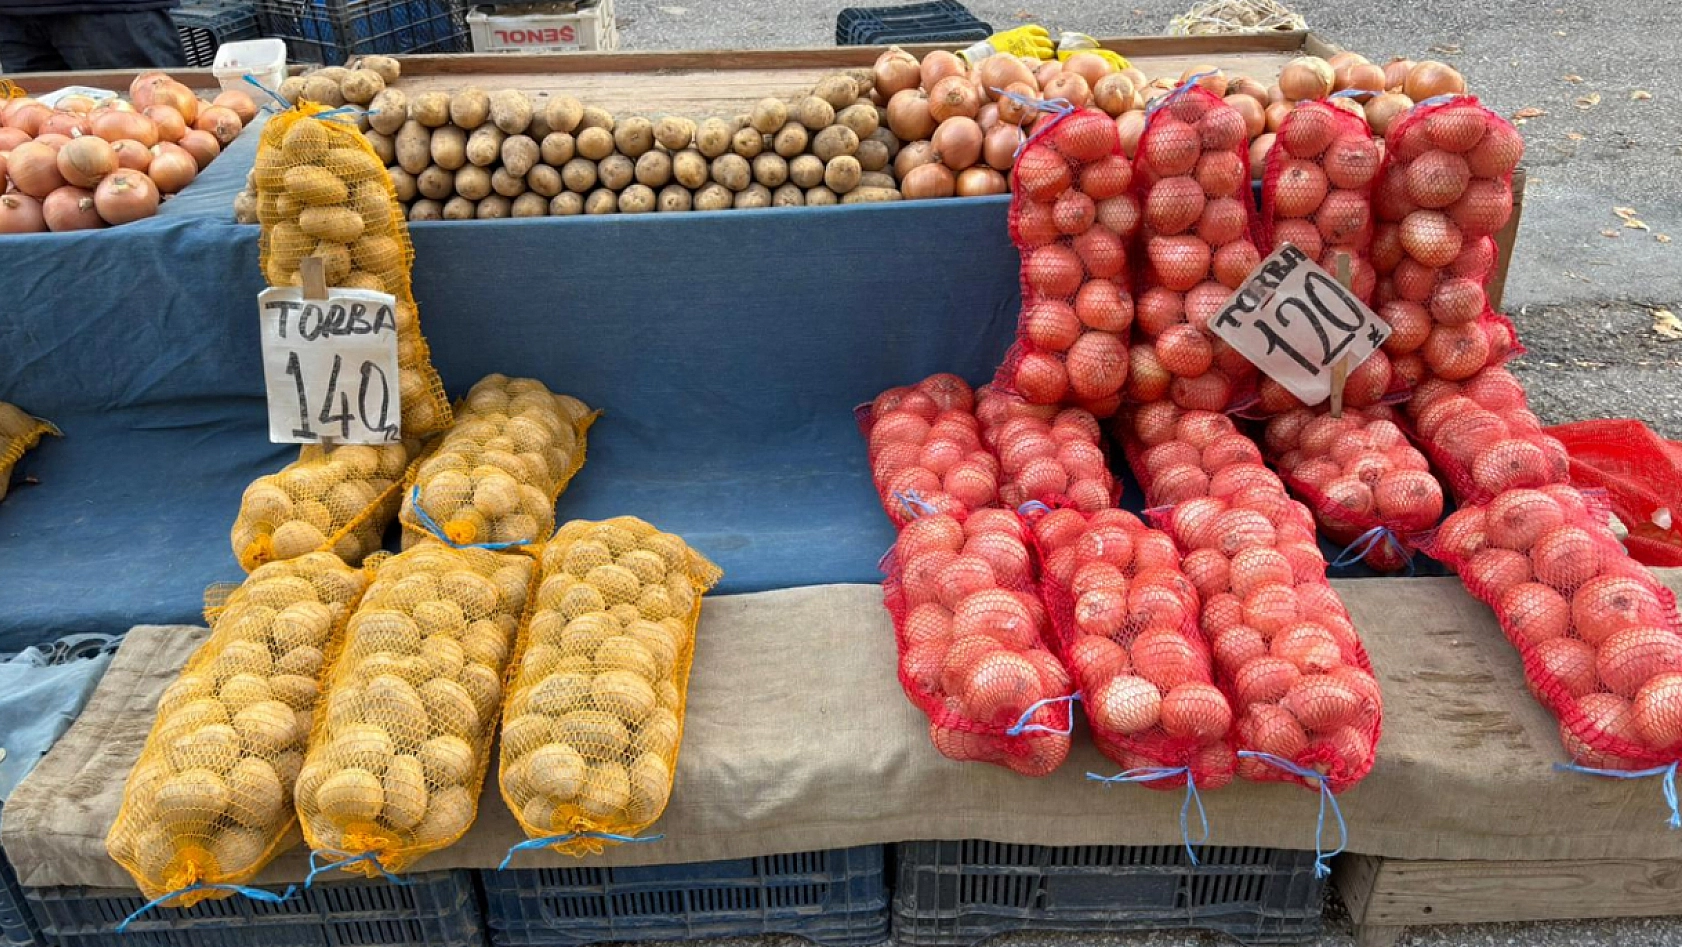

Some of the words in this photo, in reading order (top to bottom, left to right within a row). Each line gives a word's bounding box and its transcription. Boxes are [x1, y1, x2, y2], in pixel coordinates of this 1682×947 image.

[264, 300, 396, 342] TORBA
[1214, 245, 1308, 328] TORBA
[1253, 271, 1366, 376] 120
[285, 351, 389, 440] 140
